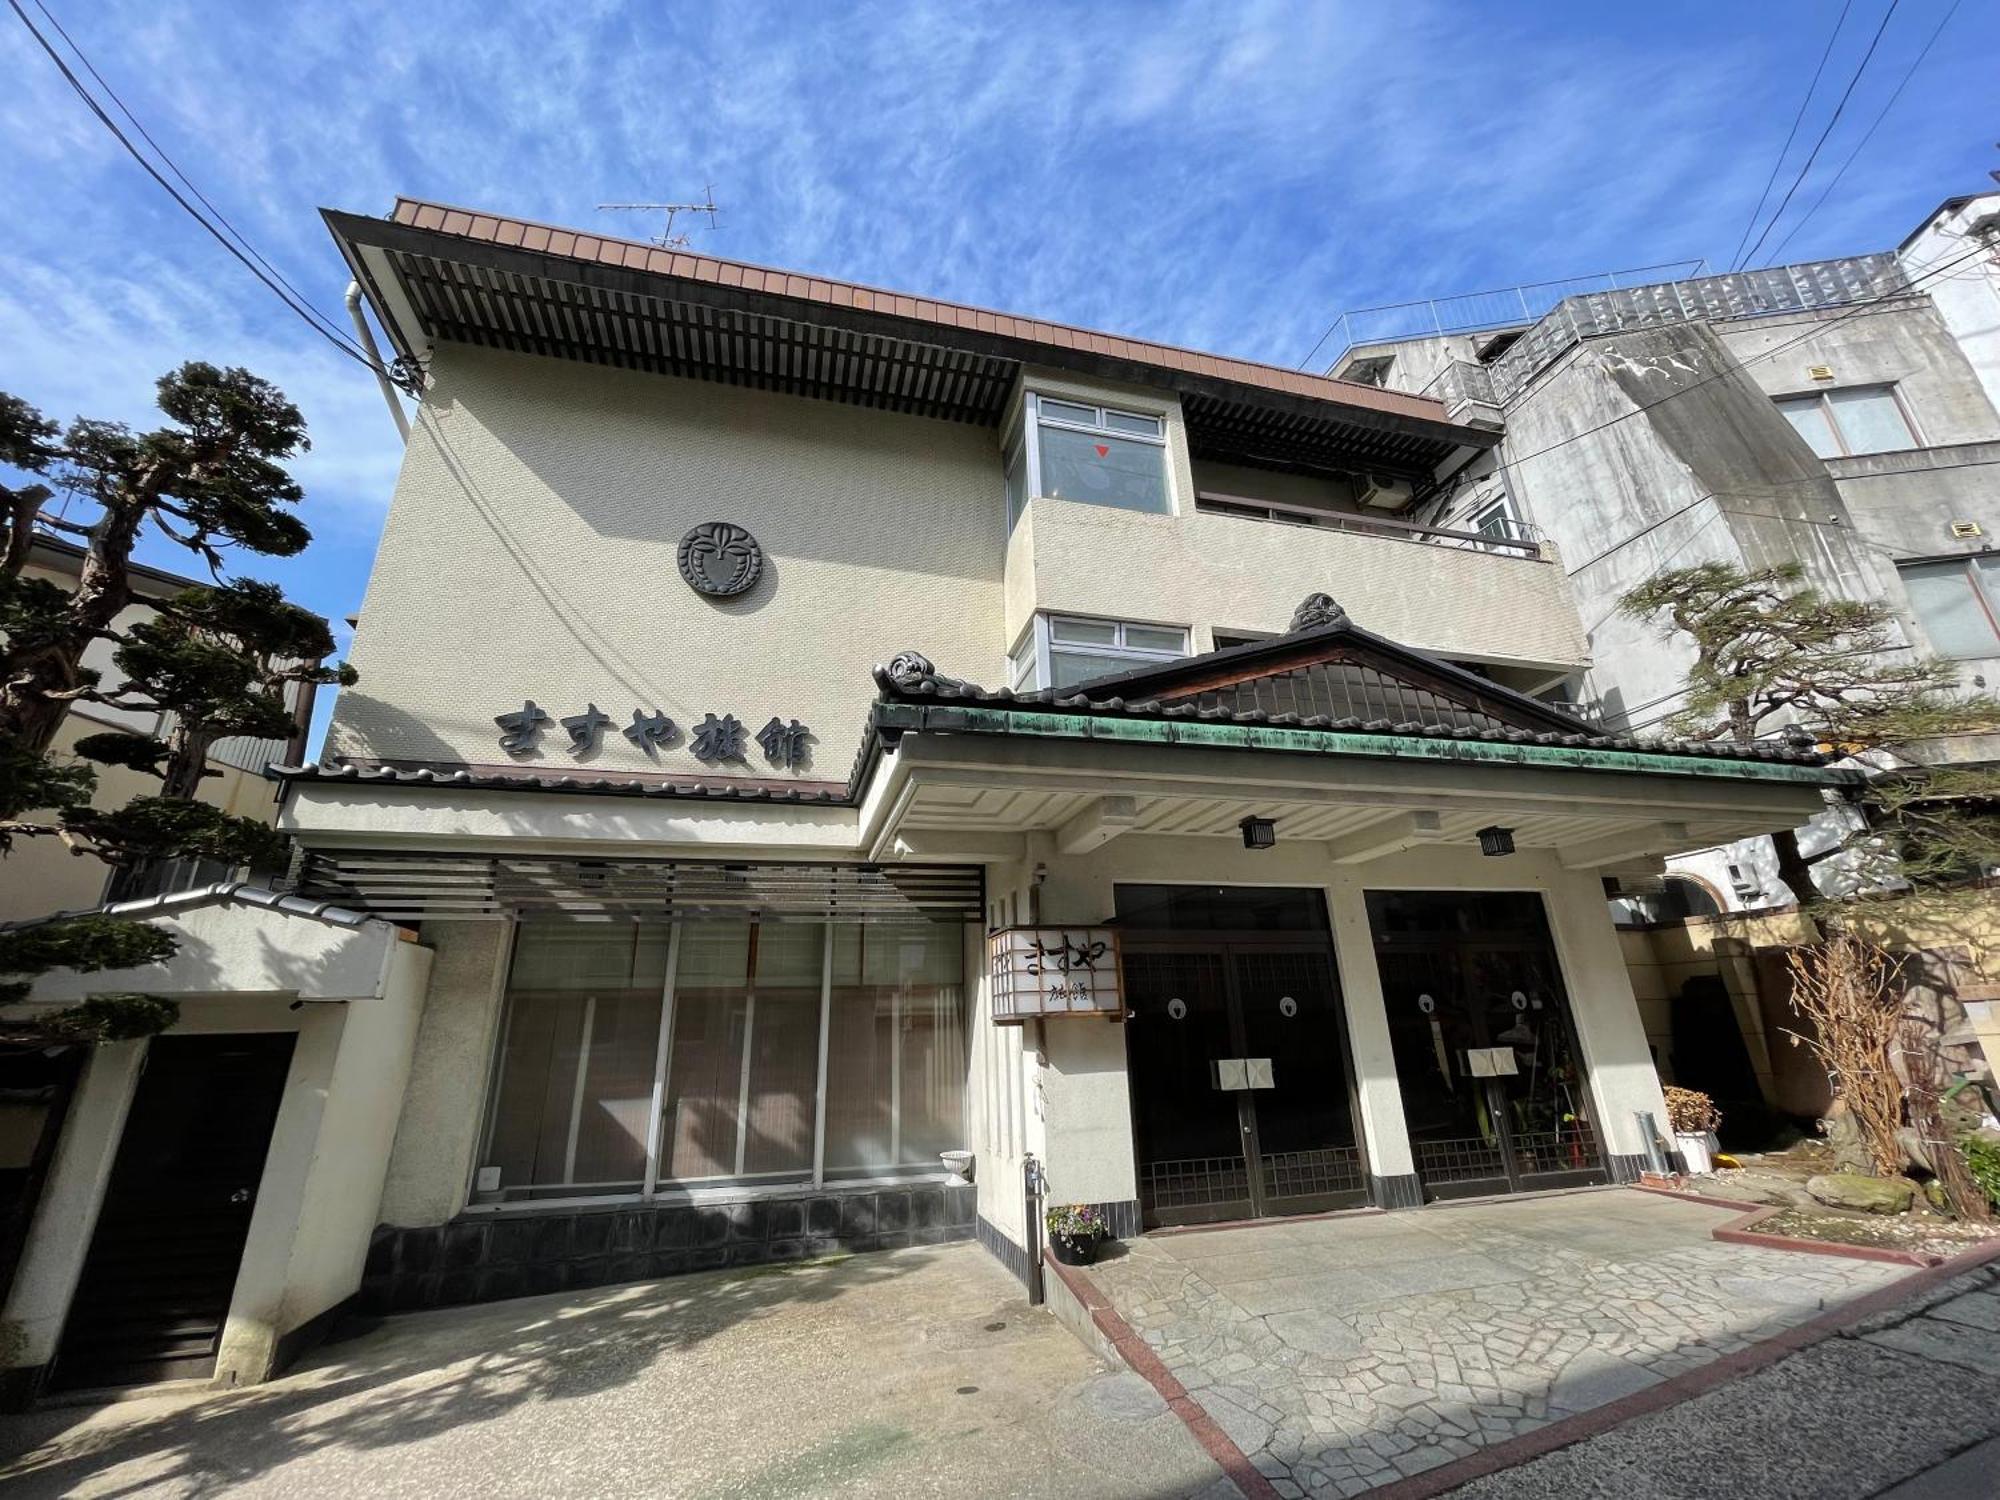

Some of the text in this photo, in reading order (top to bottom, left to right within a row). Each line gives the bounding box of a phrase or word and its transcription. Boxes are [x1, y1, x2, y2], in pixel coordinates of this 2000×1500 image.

[494, 700, 811, 769] ますや旅館
[1024, 934, 1106, 976] ますや
